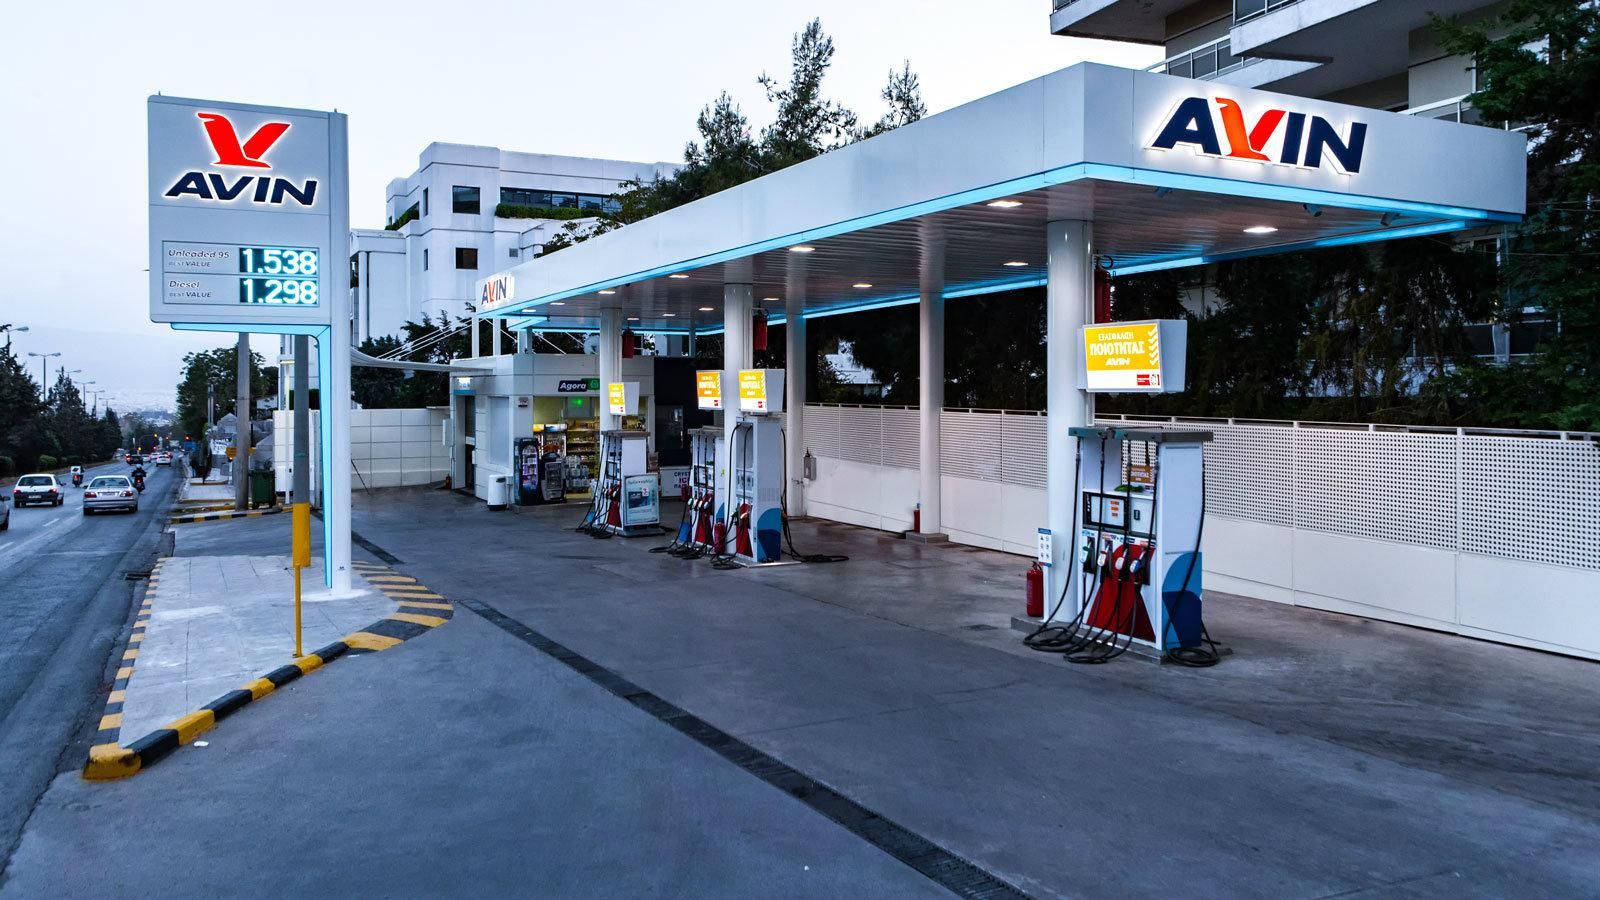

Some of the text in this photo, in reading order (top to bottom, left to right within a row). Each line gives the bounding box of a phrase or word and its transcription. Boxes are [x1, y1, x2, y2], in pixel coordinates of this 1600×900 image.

[1148, 96, 1368, 174] AVIN
[164, 171, 319, 206] AVIN
[168, 249, 230, 259] Unleaded 95
[242, 248, 317, 275] 1.538
[169, 280, 200, 288] Diesel
[243, 278, 318, 305] 1.298
[481, 276, 507, 305] AVIN
[1089, 341, 1145, 356] ΠΟΙΟΤΗΤΑΣ
[559, 382, 587, 391] Agora
